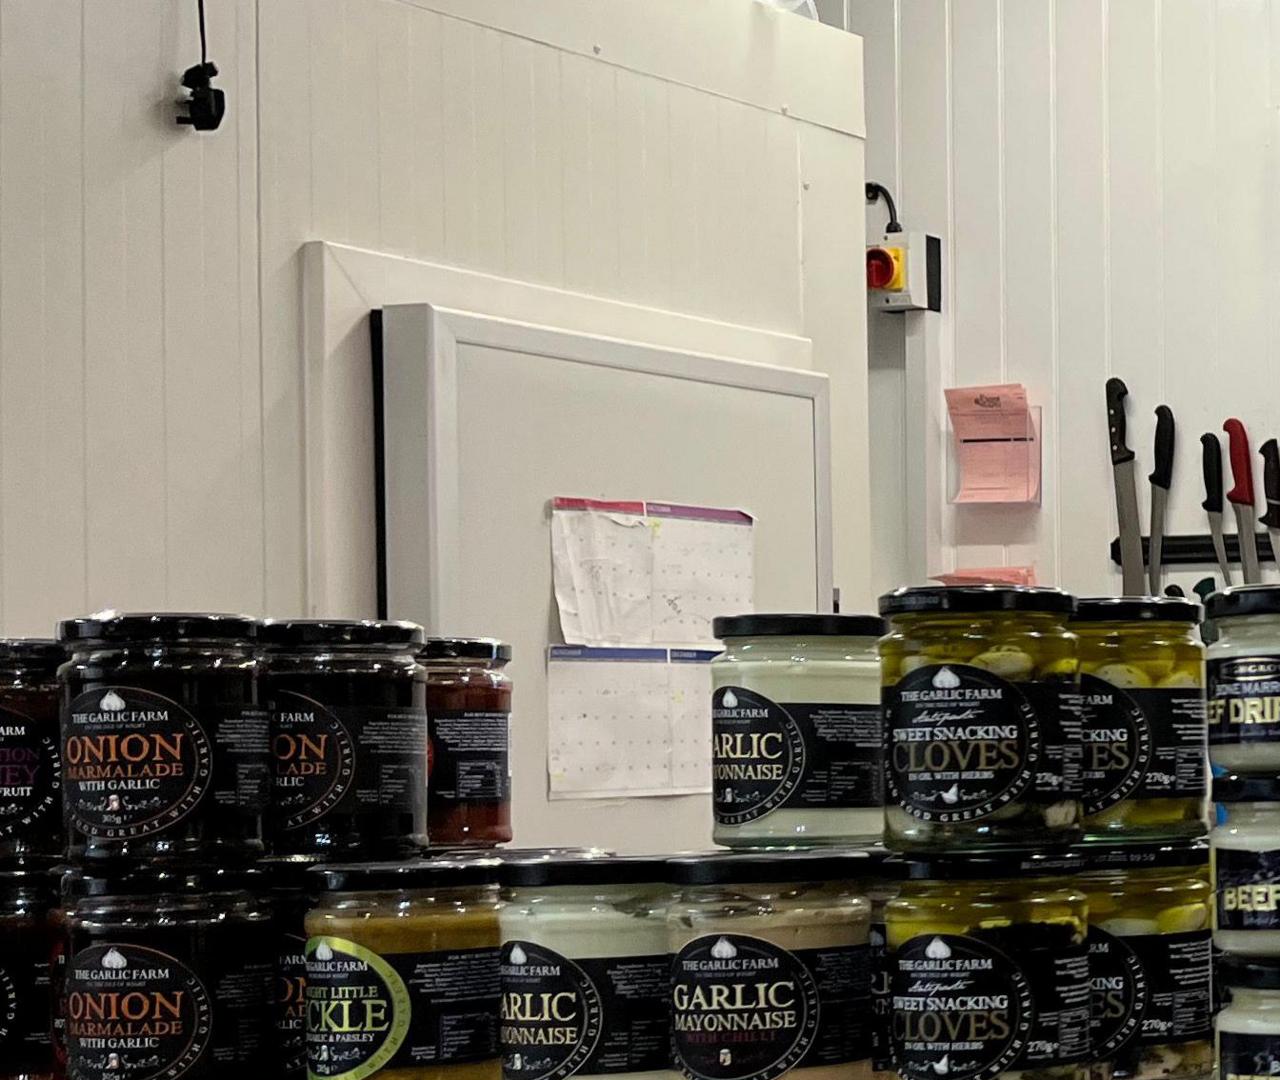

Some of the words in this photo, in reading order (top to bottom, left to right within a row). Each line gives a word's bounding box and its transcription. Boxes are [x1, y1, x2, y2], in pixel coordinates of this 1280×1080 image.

[901, 691, 920, 701] THE
[920, 689, 964, 700] GARLIC
[965, 689, 1002, 699] FARM
[72, 713, 89, 724] THE
[89, 712, 130, 723] GARLIC
[131, 711, 169, 722] FARM
[281, 712, 314, 723] FARM
[741, 709, 769, 718] FARM
[893, 728, 933, 742] SWEET
[934, 725, 1018, 741] SNACKING
[66, 733, 184, 764] ONION
[893, 740, 1020, 773] CLOVES
[66, 763, 183, 779] MARMALADE
[79, 781, 105, 791] WITH
[107, 779, 160, 790] GARLIC
[337, 960, 369, 972] FARM
[530, 965, 561, 976] FARM
[682, 961, 699, 970] THE
[699, 960, 740, 970] GARLIC
[742, 958, 779, 969] FARM
[914, 960, 955, 970] GARLIC
[956, 959, 993, 970] FARM
[75, 970, 90, 980] THE
[91, 969, 130, 980] GARLIC
[132, 969, 169, 979] FARM
[331, 985, 379, 999] LITTLE
[674, 981, 795, 1010] GARLIC
[69, 991, 184, 1020] ONION
[927, 995, 1009, 1010] SNACKING
[675, 1011, 797, 1031] MAYONNAISE
[893, 1010, 1011, 1041] CLOVES
[70, 1021, 183, 1036] MARMALADE
[79, 1038, 105, 1048] WITH
[108, 1038, 160, 1049] GARLIC
[335, 1033, 375, 1042] PARSLEY
